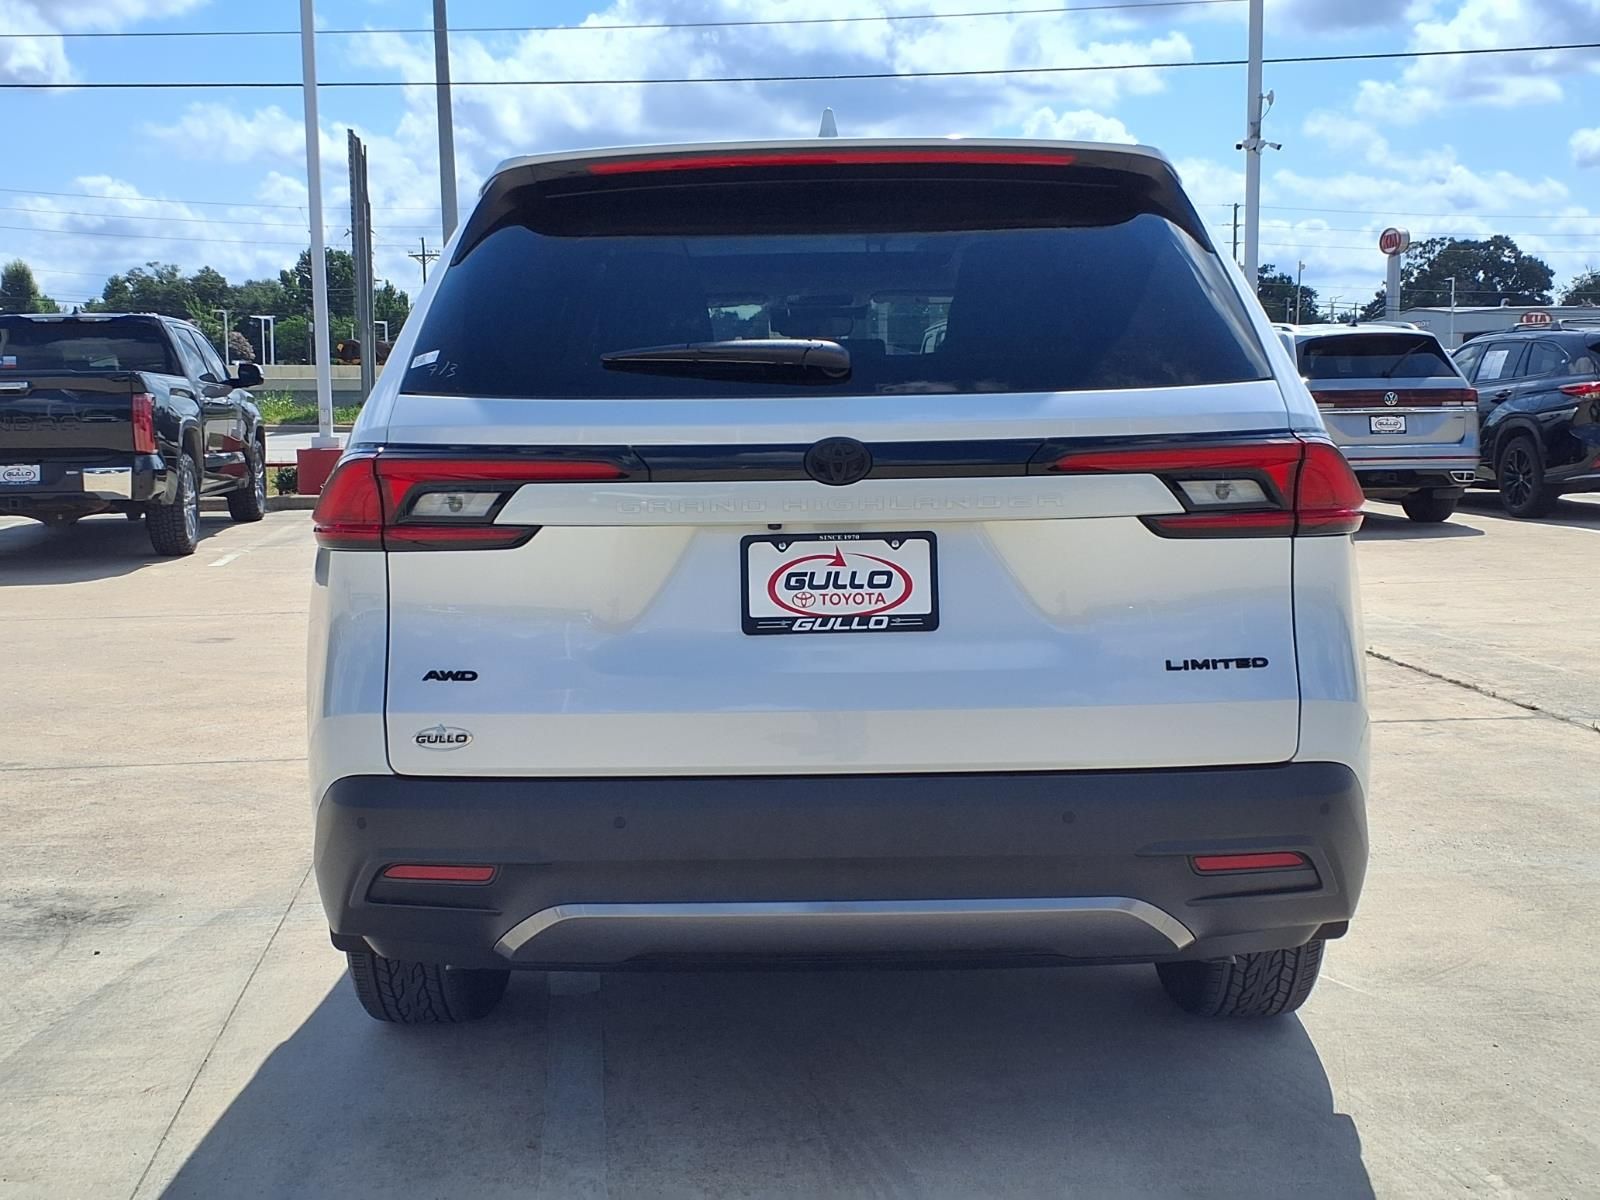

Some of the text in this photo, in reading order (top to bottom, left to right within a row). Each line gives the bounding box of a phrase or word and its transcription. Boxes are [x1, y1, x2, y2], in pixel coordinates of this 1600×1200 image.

[1382, 232, 1398, 249] KIA
[1524, 312, 1548, 324] KIA
[616, 496, 1066, 514] GRAND HIGHLANDER
[784, 571, 893, 591] GULLO
[819, 592, 887, 606] TOYOTA
[791, 616, 889, 631] GULLO
[1165, 657, 1269, 671] LIMITED
[421, 670, 478, 681] AWD
[415, 734, 468, 744] GULLO
